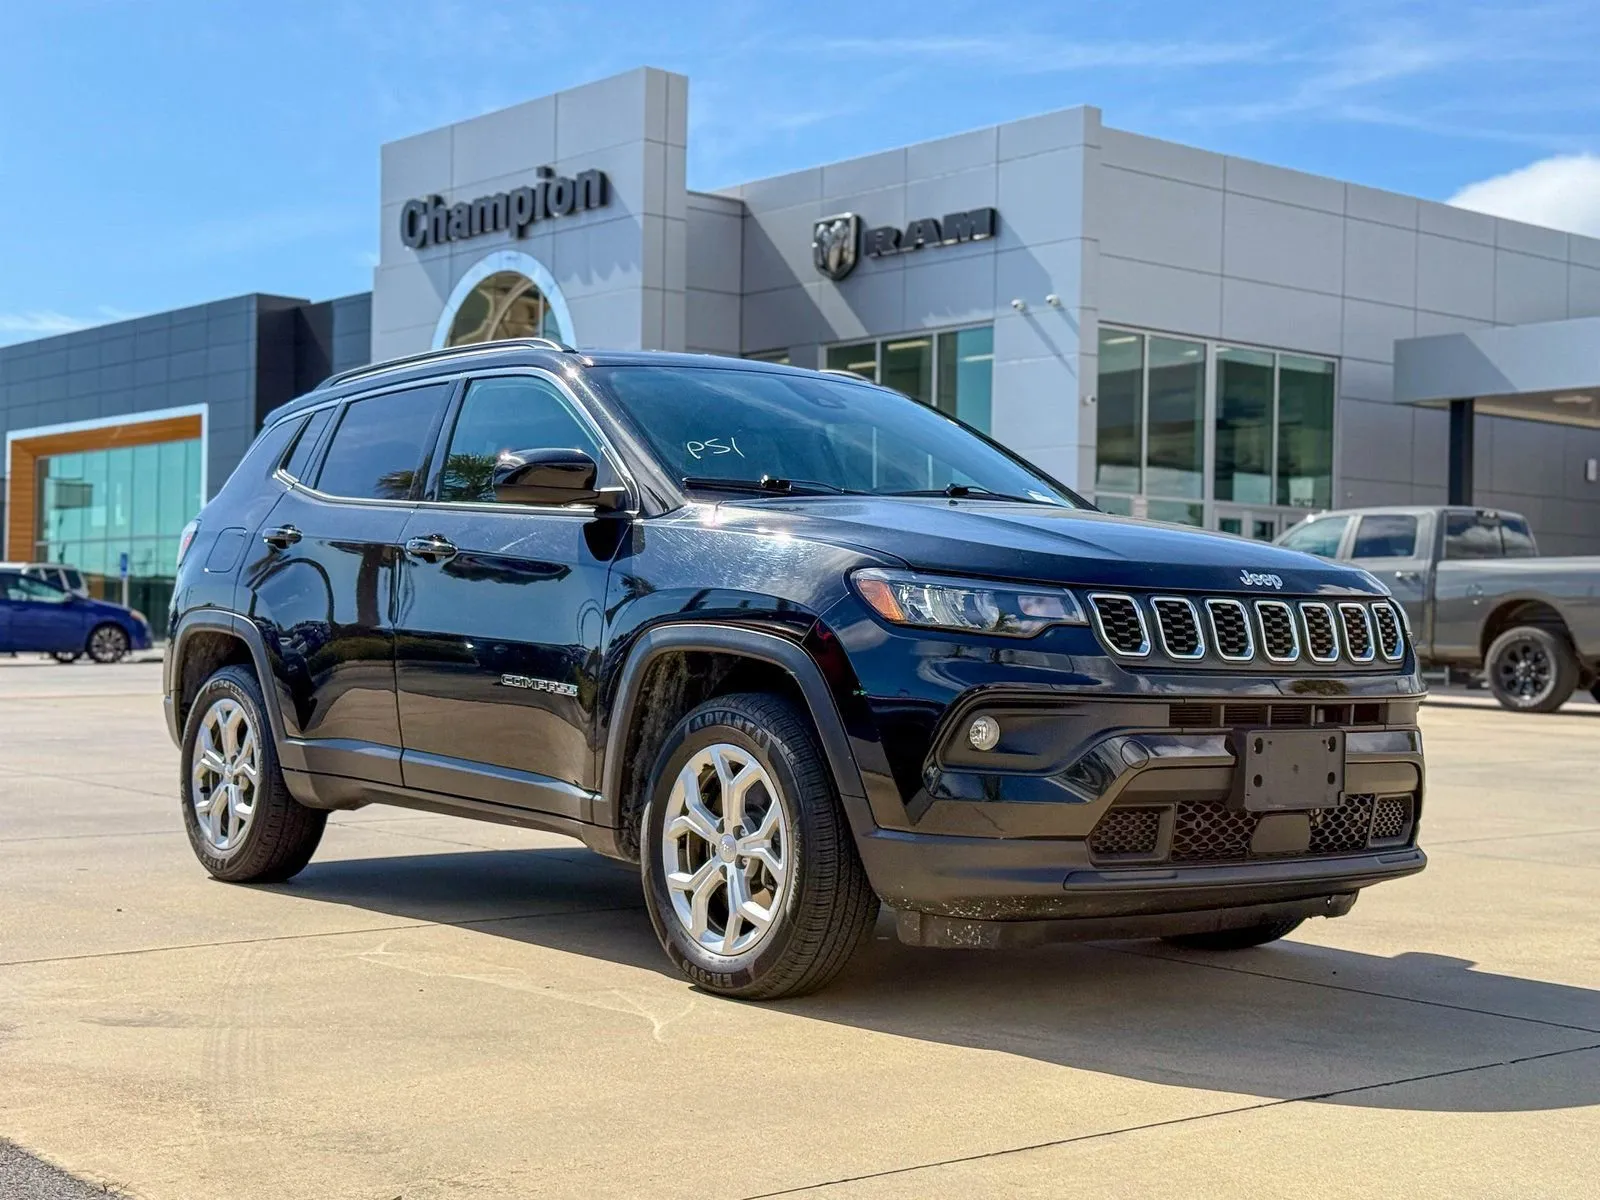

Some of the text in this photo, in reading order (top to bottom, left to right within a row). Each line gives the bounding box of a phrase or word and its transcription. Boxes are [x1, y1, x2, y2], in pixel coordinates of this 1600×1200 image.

[401, 166, 609, 249] Champion
[863, 207, 997, 259] RAM
[1240, 570, 1283, 590] Jeep
[501, 674, 578, 697] COMPASS
